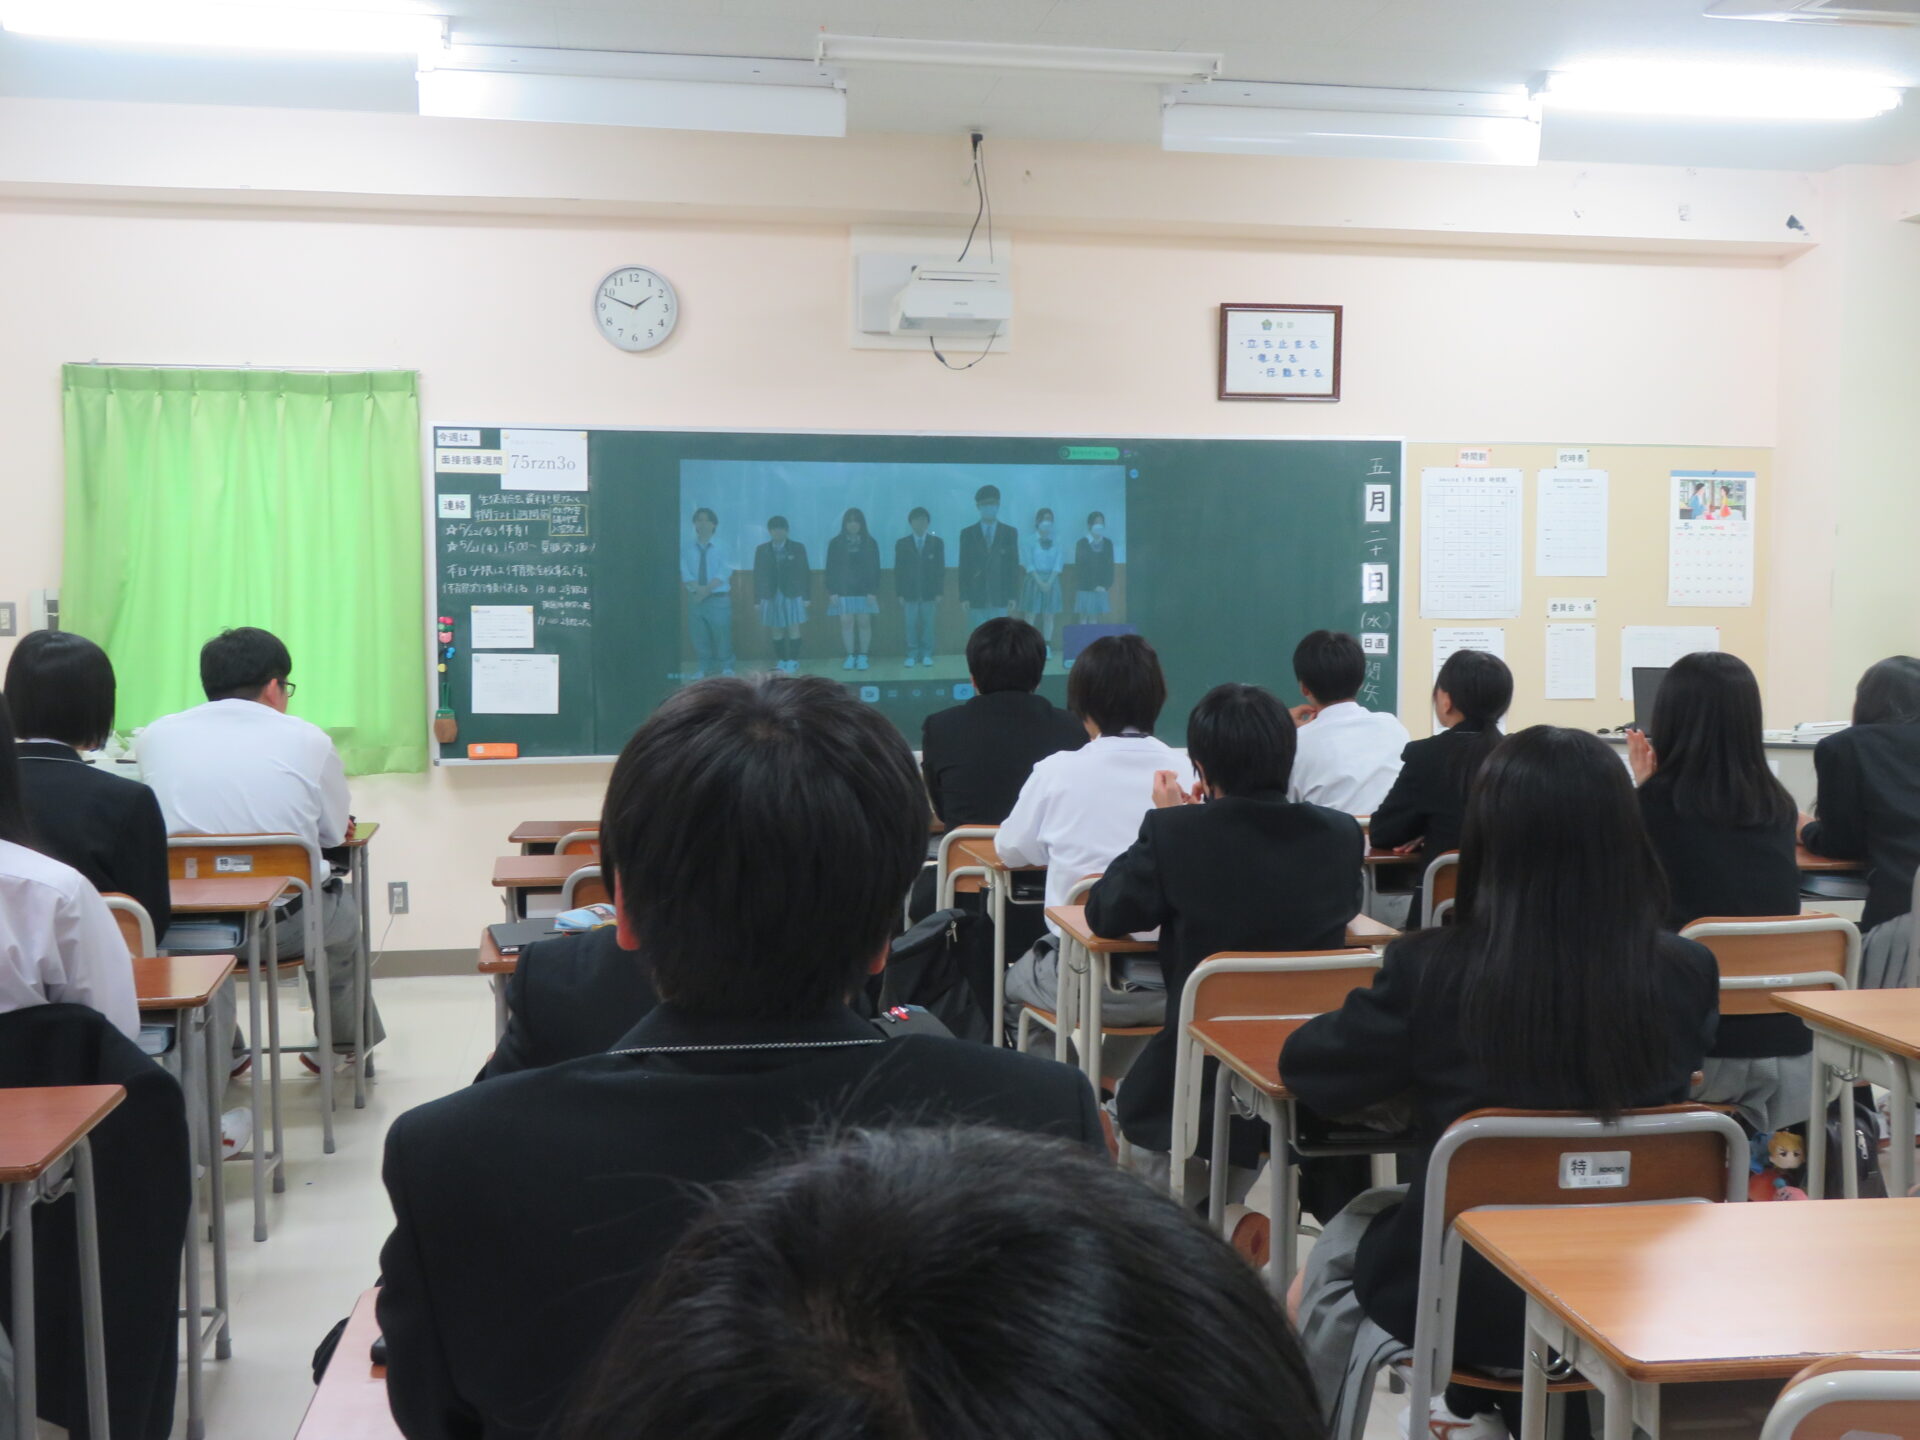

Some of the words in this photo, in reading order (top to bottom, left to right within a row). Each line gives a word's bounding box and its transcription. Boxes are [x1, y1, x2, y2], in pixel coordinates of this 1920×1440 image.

[614, 277, 623, 287] 11
[629, 273, 640, 283] 12
[604, 288, 615, 297] 10
[658, 289, 664, 298] 2
[600, 303, 607, 311] 9
[663, 303, 669, 313] 3
[606, 316, 613, 326] 8
[657, 319, 664, 327] 4
[617, 328, 623, 337] 7
[631, 333, 638, 342] 6
[648, 329, 654, 338] 5
[441, 454, 504, 466] 面接指導週間
[1460, 452, 1487, 462] 時間割
[1559, 453, 1585, 463] 校時表
[443, 500, 467, 511] 連絡
[1364, 638, 1385, 649] 日直
[1570, 1159, 1587, 1176] 特
